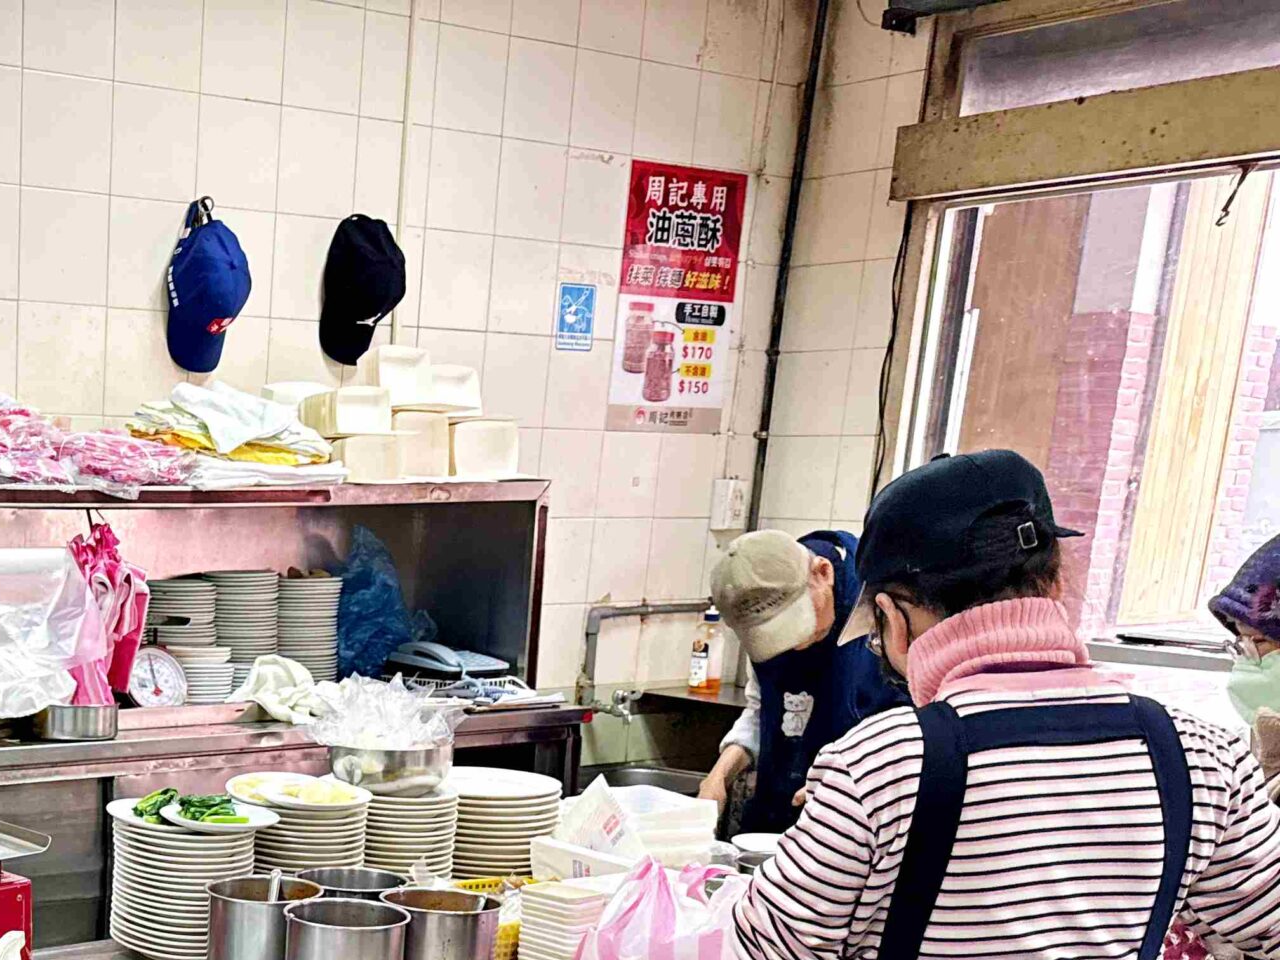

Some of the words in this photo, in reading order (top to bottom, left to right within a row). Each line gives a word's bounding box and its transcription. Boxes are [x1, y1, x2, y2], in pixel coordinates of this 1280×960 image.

[645, 176, 727, 212] 周記專用
[646, 208, 723, 252] 油蔥酥
[684, 304, 718, 318] 手工自製
[682, 345, 712, 360] $170
[678, 380, 708, 394] $150
